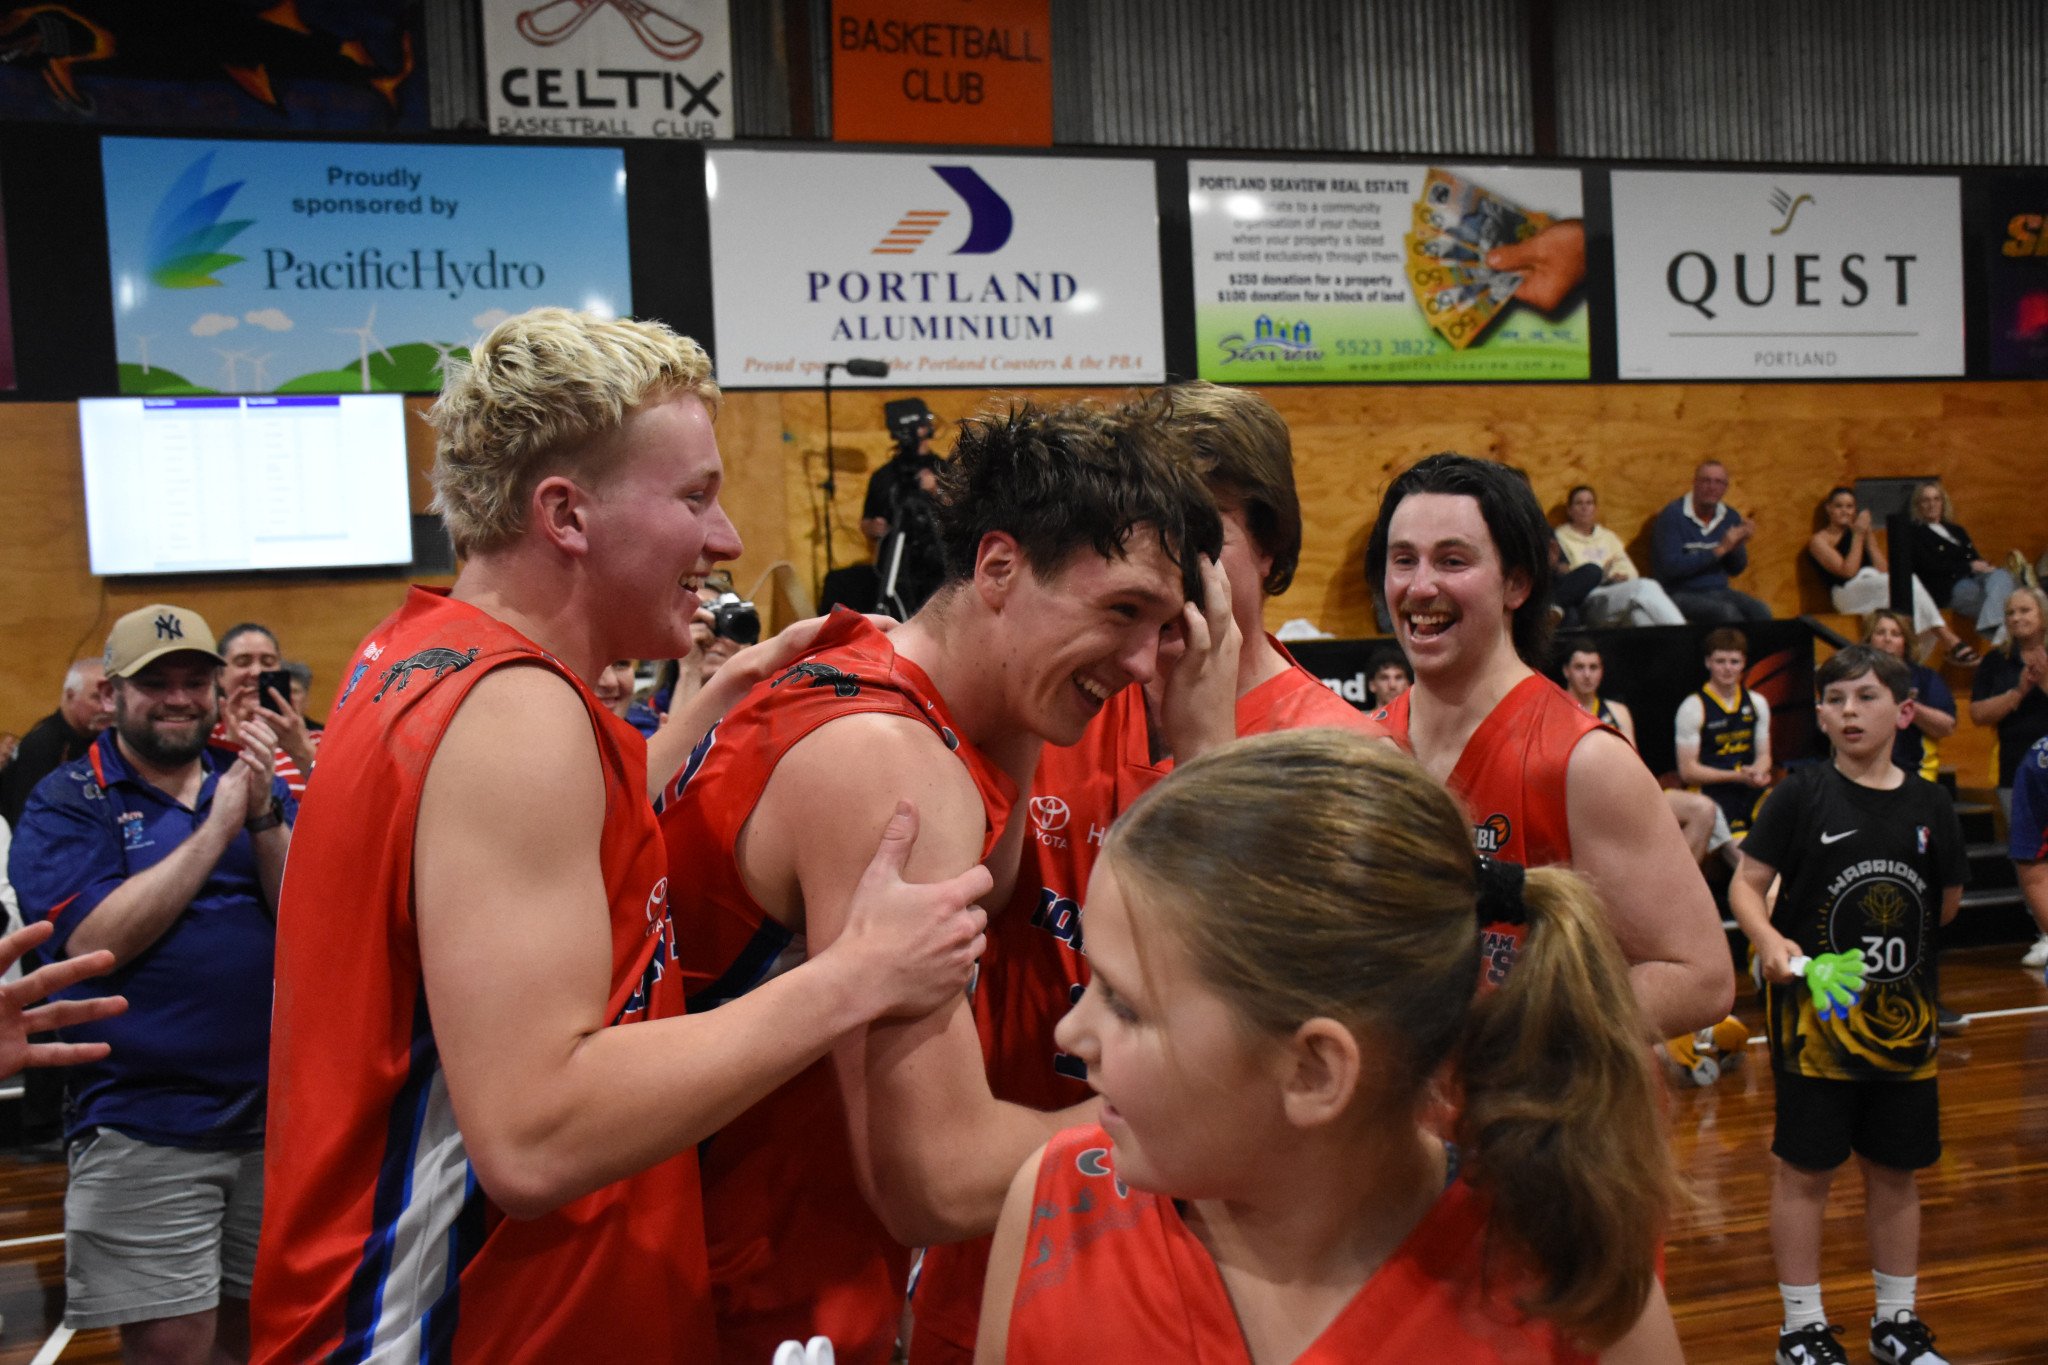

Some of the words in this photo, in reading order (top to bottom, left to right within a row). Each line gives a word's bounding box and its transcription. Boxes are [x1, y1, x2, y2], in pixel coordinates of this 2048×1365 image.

[839, 16, 1043, 63] BASKETBALL
[501, 67, 725, 117] CELTIX
[902, 68, 984, 104] CLUB
[497, 116, 635, 137] BASKETBALL
[652, 118, 715, 139] CLUB
[326, 165, 422, 192] Proudly
[1200, 177, 1266, 191] PORTLAND
[1270, 178, 1327, 192] SEAVIEW
[1331, 179, 1362, 193] REAL
[1365, 179, 1409, 193] ESTATE
[291, 196, 423, 217] sponsored
[430, 196, 459, 219] by
[263, 247, 546, 300] PacificHydro
[807, 270, 1079, 303] PORTLAND
[1229, 273, 1258, 286] $250
[1262, 274, 1311, 285] donation
[1315, 274, 1331, 285] for
[1335, 276, 1341, 285] a
[1344, 274, 1392, 287] property
[1666, 251, 1917, 320] QUEST
[1218, 291, 1247, 303] $100
[1250, 291, 1301, 302] donation
[1304, 291, 1320, 302] for
[1324, 294, 1331, 302] a
[1333, 291, 1363, 302] block
[1366, 291, 1378, 302] of
[1380, 291, 1405, 302] land
[831, 315, 1055, 341] ALUMINIUM
[744, 356, 796, 372] Proud
[918, 356, 986, 371] Portland
[1062, 356, 1073, 370] &
[1079, 356, 1103, 370] the
[1754, 351, 1838, 367] PORTLAND
[1827, 859, 1928, 896] WARRIORS
[1861, 936, 1906, 973] 30
